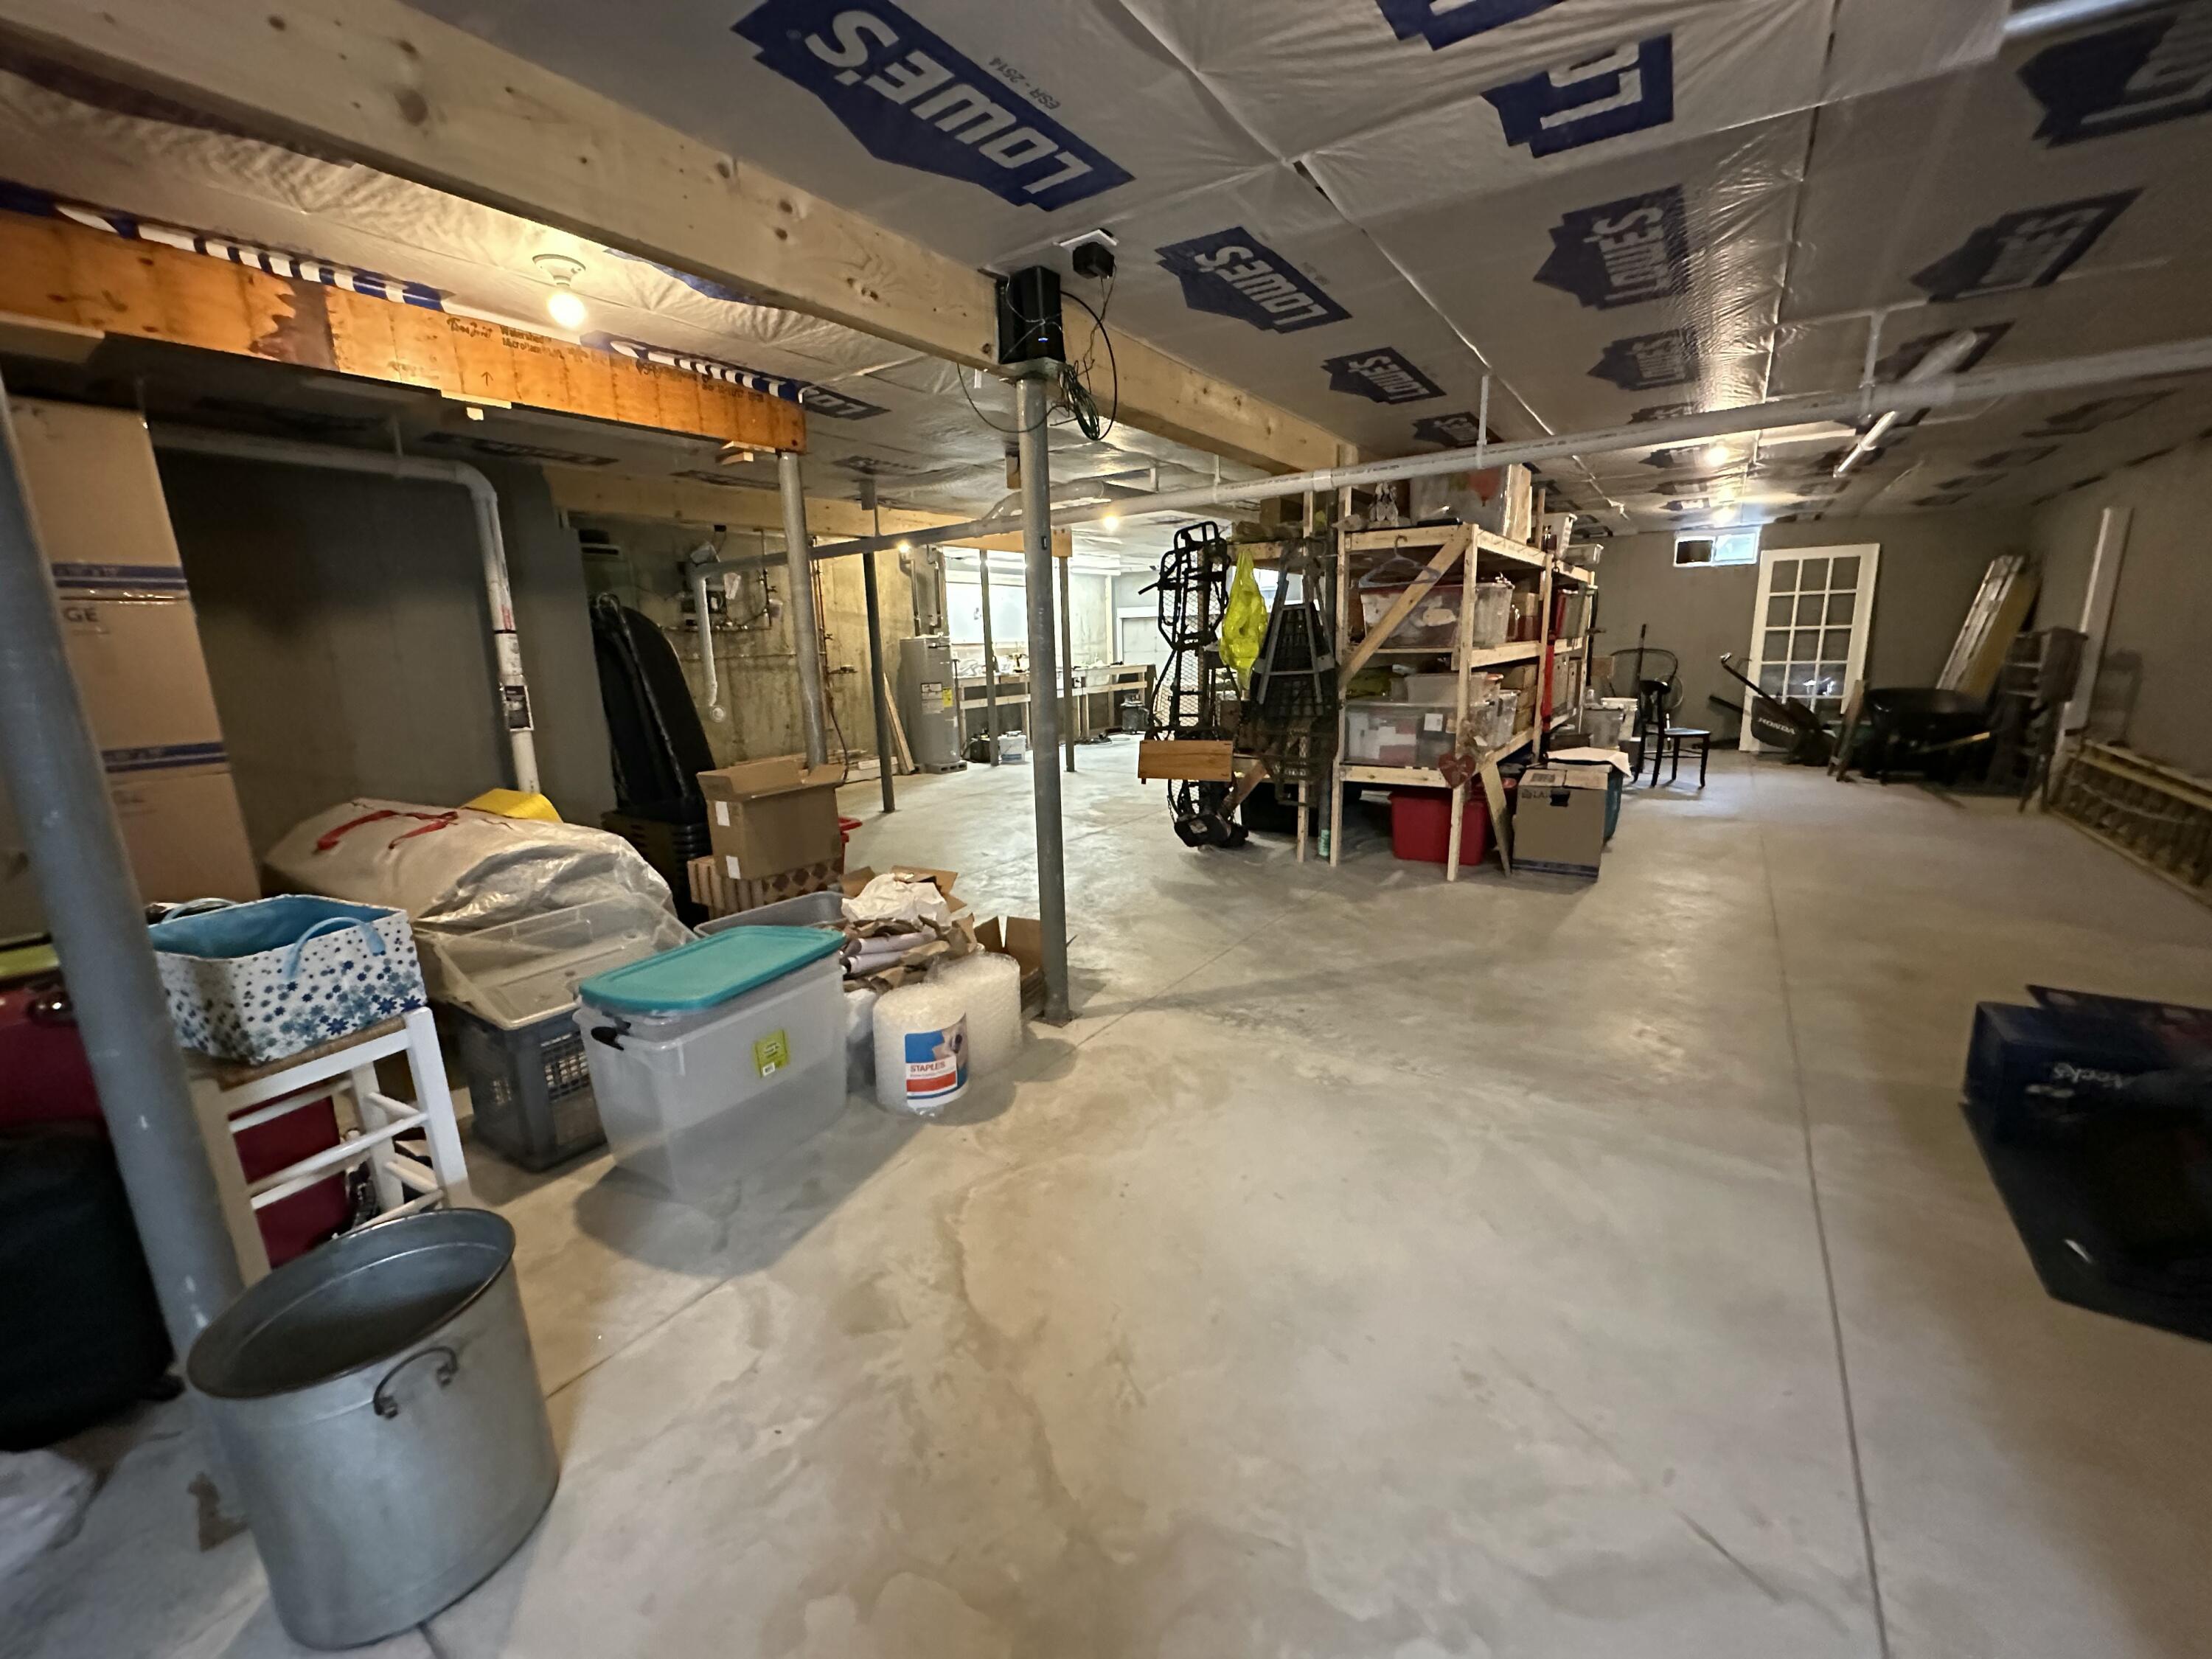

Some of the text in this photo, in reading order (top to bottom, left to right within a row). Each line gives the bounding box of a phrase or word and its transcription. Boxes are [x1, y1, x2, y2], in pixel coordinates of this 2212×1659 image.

[804, 10, 1093, 194] LOWE'S
[1029, 87, 1061, 110] ESR
[1582, 206, 1672, 301] LOWE'S
[1194, 246, 1329, 325] LOWE'S
[1347, 355, 1431, 400] LOWE'S
[1758, 717, 1796, 735] HONDA
[911, 1062, 946, 1073] STAPLES
